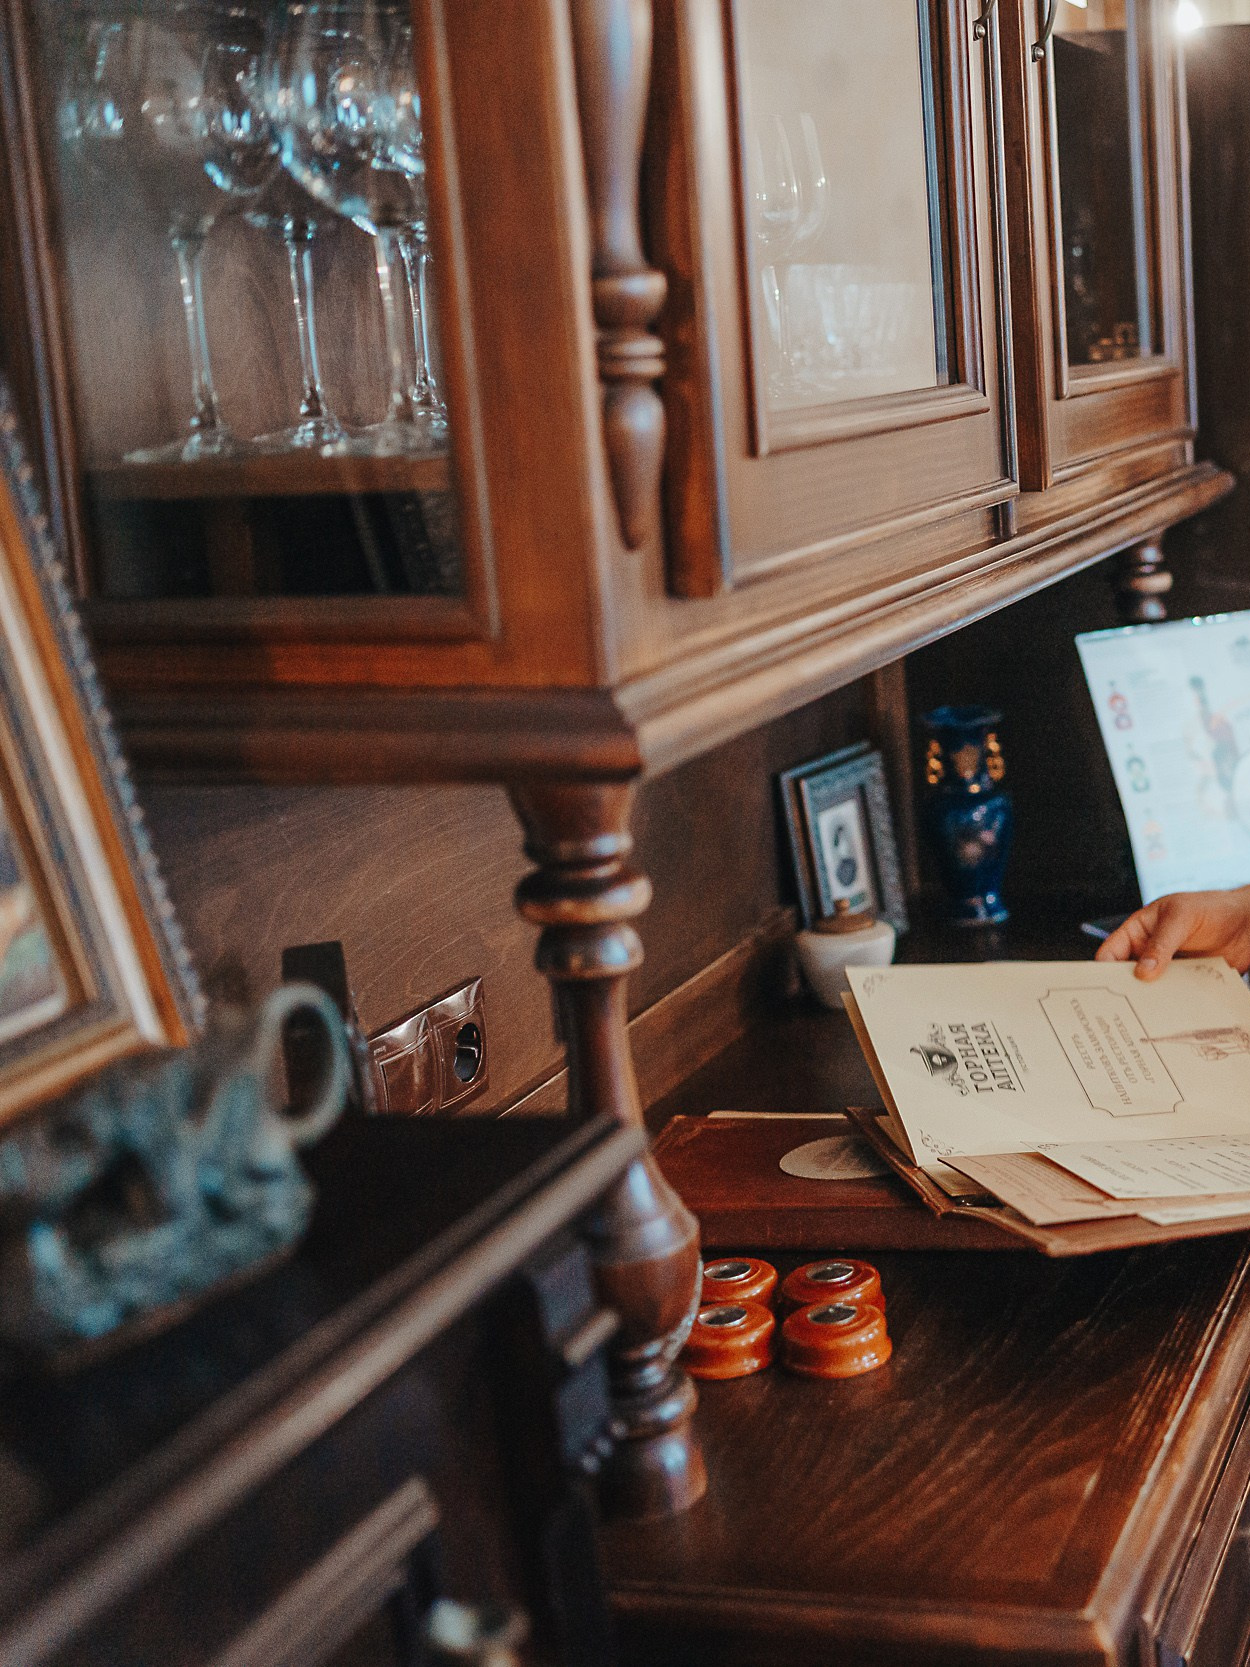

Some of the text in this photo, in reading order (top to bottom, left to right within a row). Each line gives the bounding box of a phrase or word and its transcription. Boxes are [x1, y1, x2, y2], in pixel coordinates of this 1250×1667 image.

[948, 1023, 994, 1093] ГОРНАЯ
[971, 1022, 1016, 1092] АПТЕКА
[1070, 1033, 1096, 1070] РЕЕСТРЪ
[1121, 1066, 1139, 1084] ОТЪ
[1098, 1054, 1133, 1105] НАПИТКОВЪ
